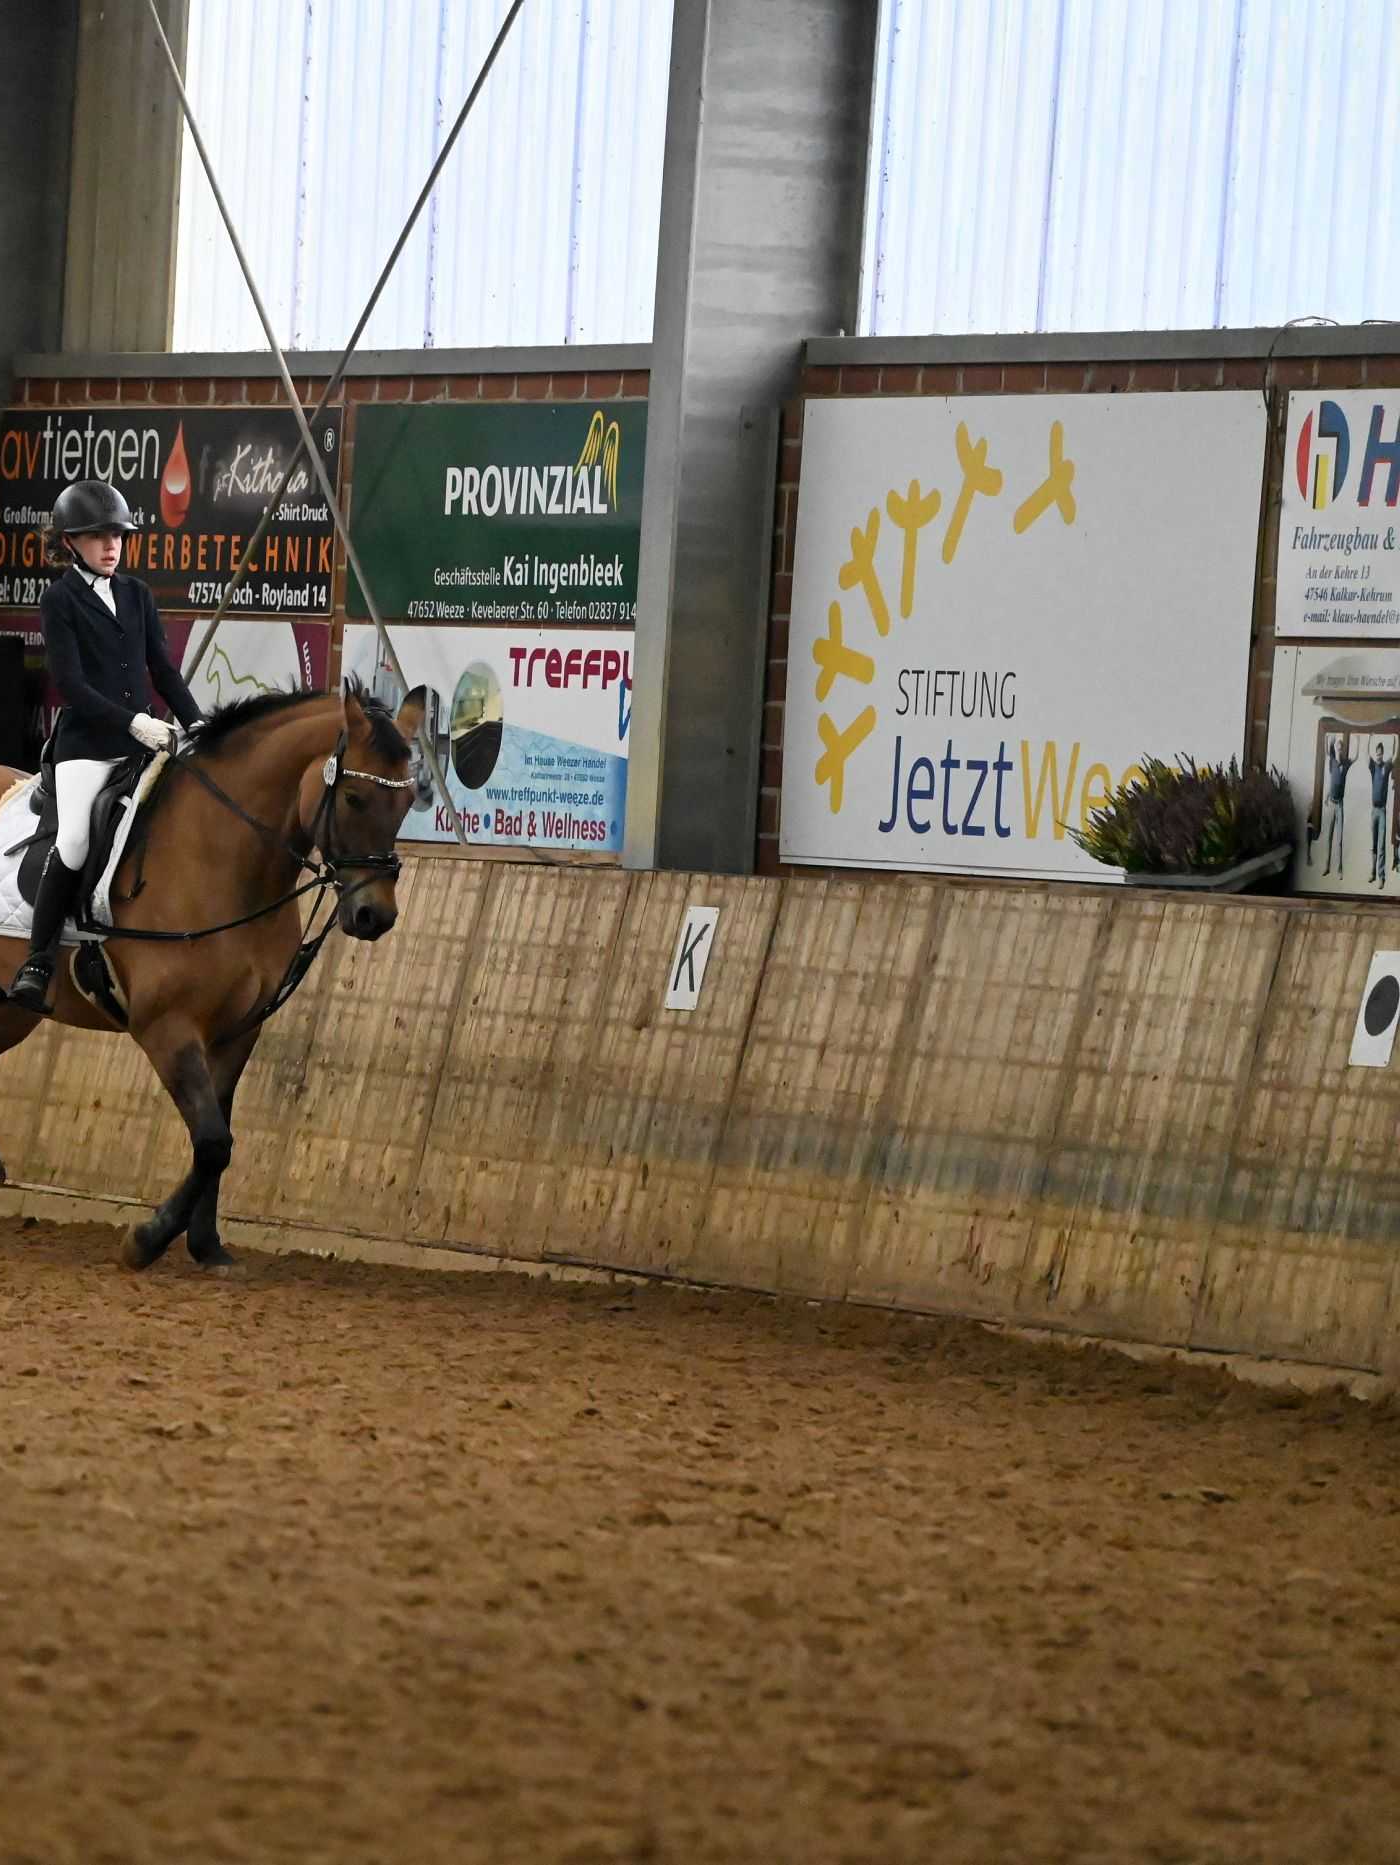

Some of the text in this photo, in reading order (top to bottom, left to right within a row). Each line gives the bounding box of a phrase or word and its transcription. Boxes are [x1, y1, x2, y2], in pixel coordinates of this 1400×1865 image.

[444, 465, 608, 516] PROVINZIAL
[301, 503, 328, 521] Druck
[1292, 526, 1395, 556] Fahrzeugbau &
[433, 554, 624, 594] Geschäftsstelle Kai Ingenbleek
[188, 582, 222, 604] 47574
[261, 583, 309, 611] Royland
[312, 585, 327, 607] 14
[407, 601, 435, 619] 47652
[436, 601, 465, 619] Weeze
[471, 601, 520, 620] Kevelaerer
[521, 602, 535, 620] Str.
[537, 602, 549, 619] 60
[555, 601, 587, 621] Telefon
[896, 669, 1017, 719] STIFTUNG
[486, 787, 604, 806] www.treffpunkt-weeze.de
[494, 809, 523, 836] Bad
[527, 811, 537, 838] &
[542, 811, 606, 841] Wellness
[673, 922, 710, 992] K
